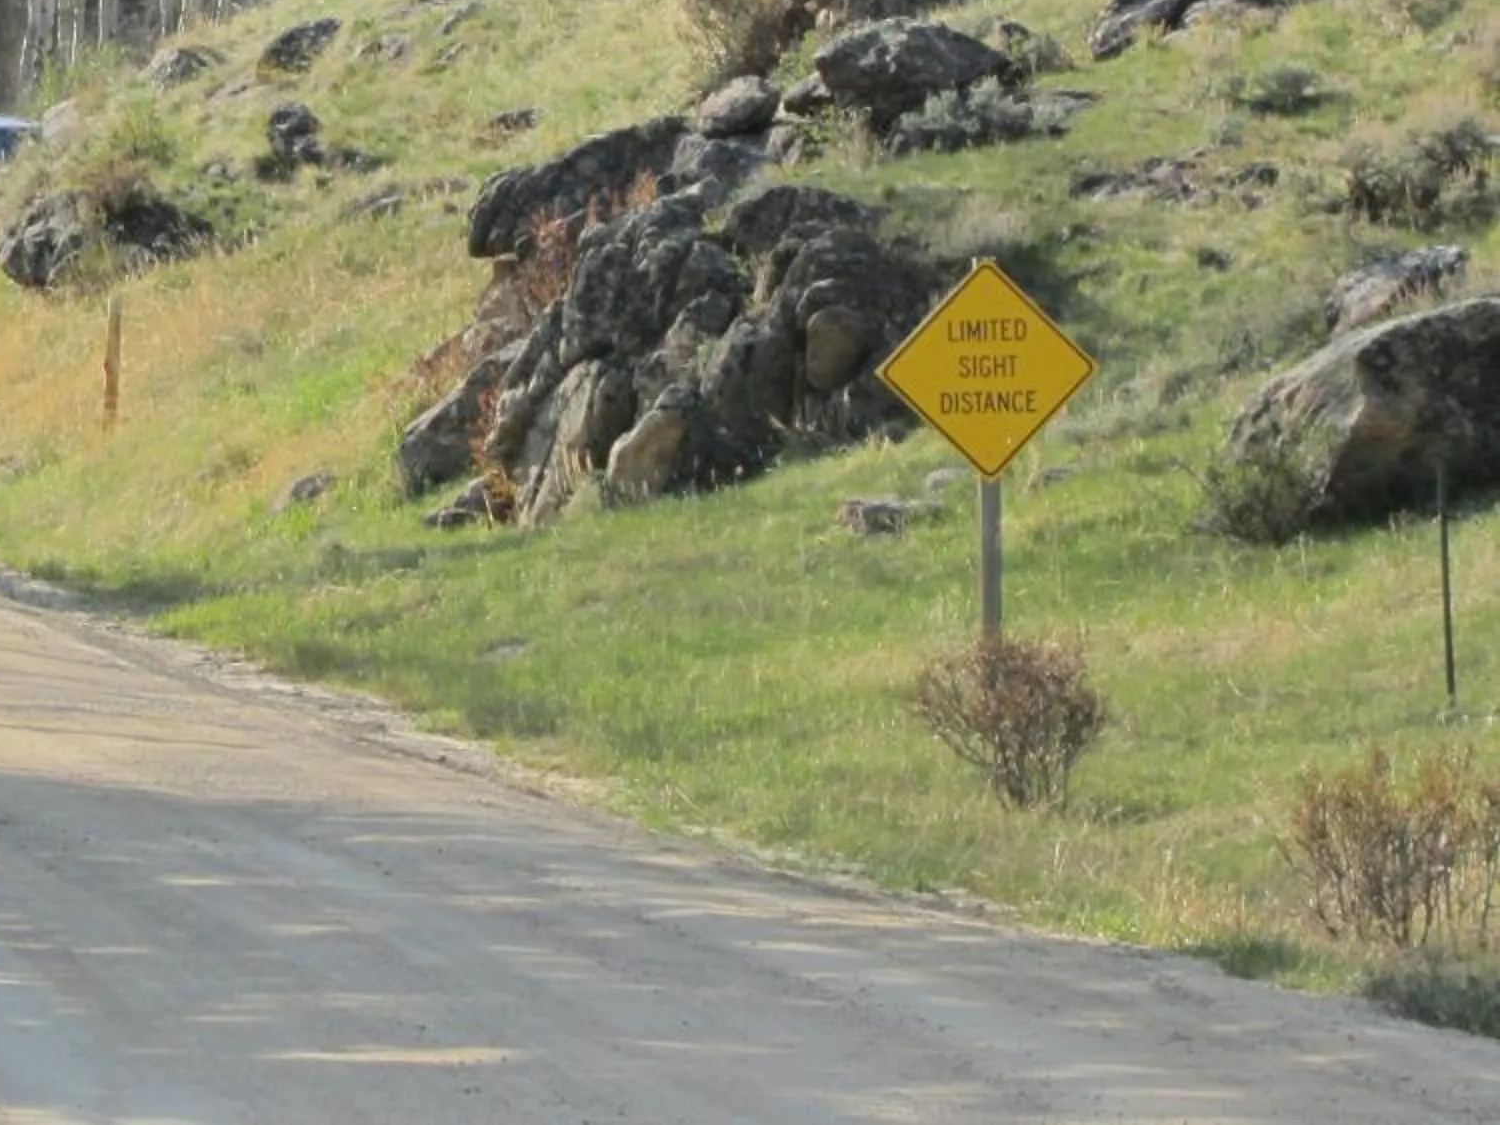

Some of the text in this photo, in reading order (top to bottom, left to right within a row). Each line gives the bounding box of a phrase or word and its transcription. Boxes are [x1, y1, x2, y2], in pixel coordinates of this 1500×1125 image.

[947, 318, 1028, 342] LIMITED
[958, 355, 1018, 379] SIGHT
[940, 390, 1037, 414] DISTANCE
